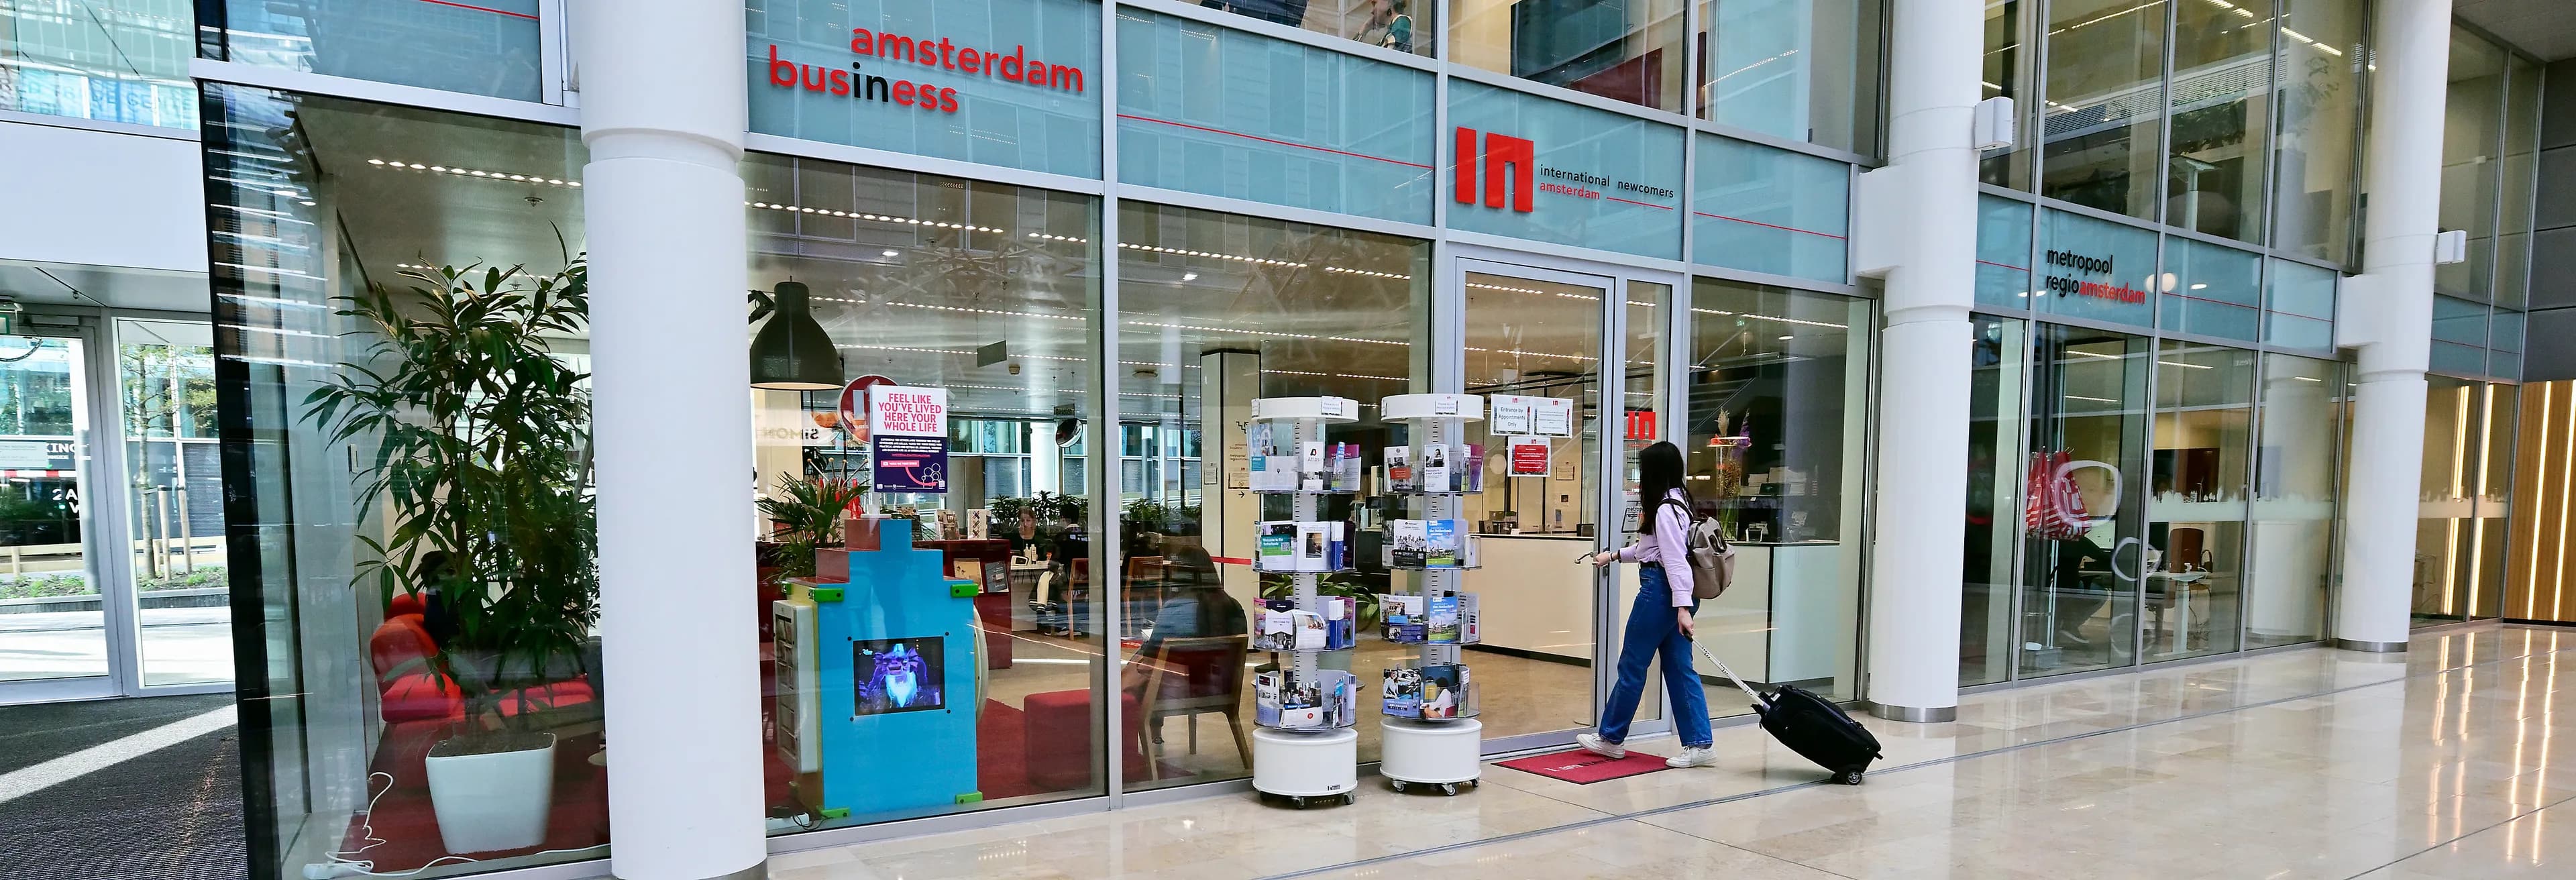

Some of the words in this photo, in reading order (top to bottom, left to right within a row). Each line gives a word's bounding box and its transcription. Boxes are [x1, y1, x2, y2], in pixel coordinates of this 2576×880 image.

[851, 28, 1083, 92] amsterdam
[769, 44, 959, 113] business
[1540, 164, 1611, 187] international
[1617, 180, 1674, 199] newcomers
[1540, 182, 1601, 201] amsterdam
[2047, 249, 2113, 276] metropool
[878, 402, 913, 412] YOU'VE
[915, 404, 942, 414] LIVED
[889, 393, 910, 403] FEEL
[912, 394, 932, 404] LIKE
[883, 422, 916, 431] WHOLE
[919, 423, 938, 432] LIFE
[884, 412, 908, 422] HERE
[911, 413, 936, 423] YOUR
